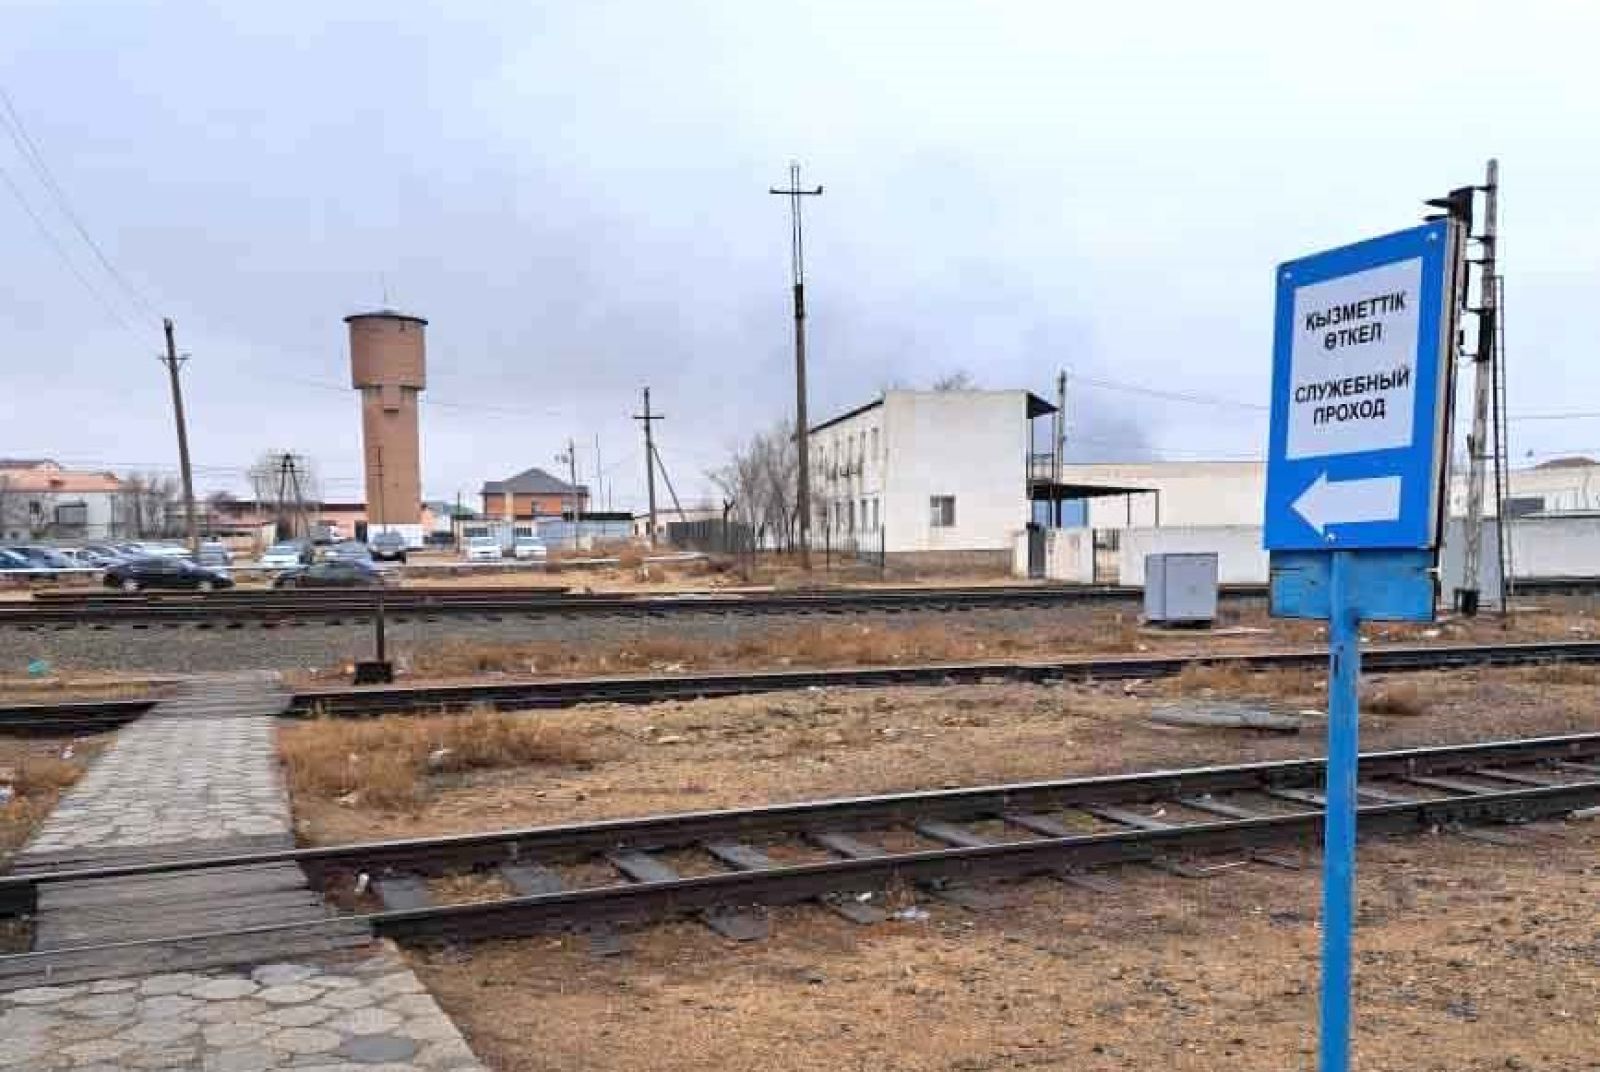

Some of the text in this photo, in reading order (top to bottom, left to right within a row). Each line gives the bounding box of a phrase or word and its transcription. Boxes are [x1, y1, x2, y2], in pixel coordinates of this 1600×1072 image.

[1306, 290, 1406, 332] ҚЫЗМЕТТІК
[1324, 323, 1382, 350] ӨТКЕЛ
[1295, 365, 1410, 403] СЛУЖЕБНЫЙ
[1313, 398, 1385, 425] ПРОХОД
